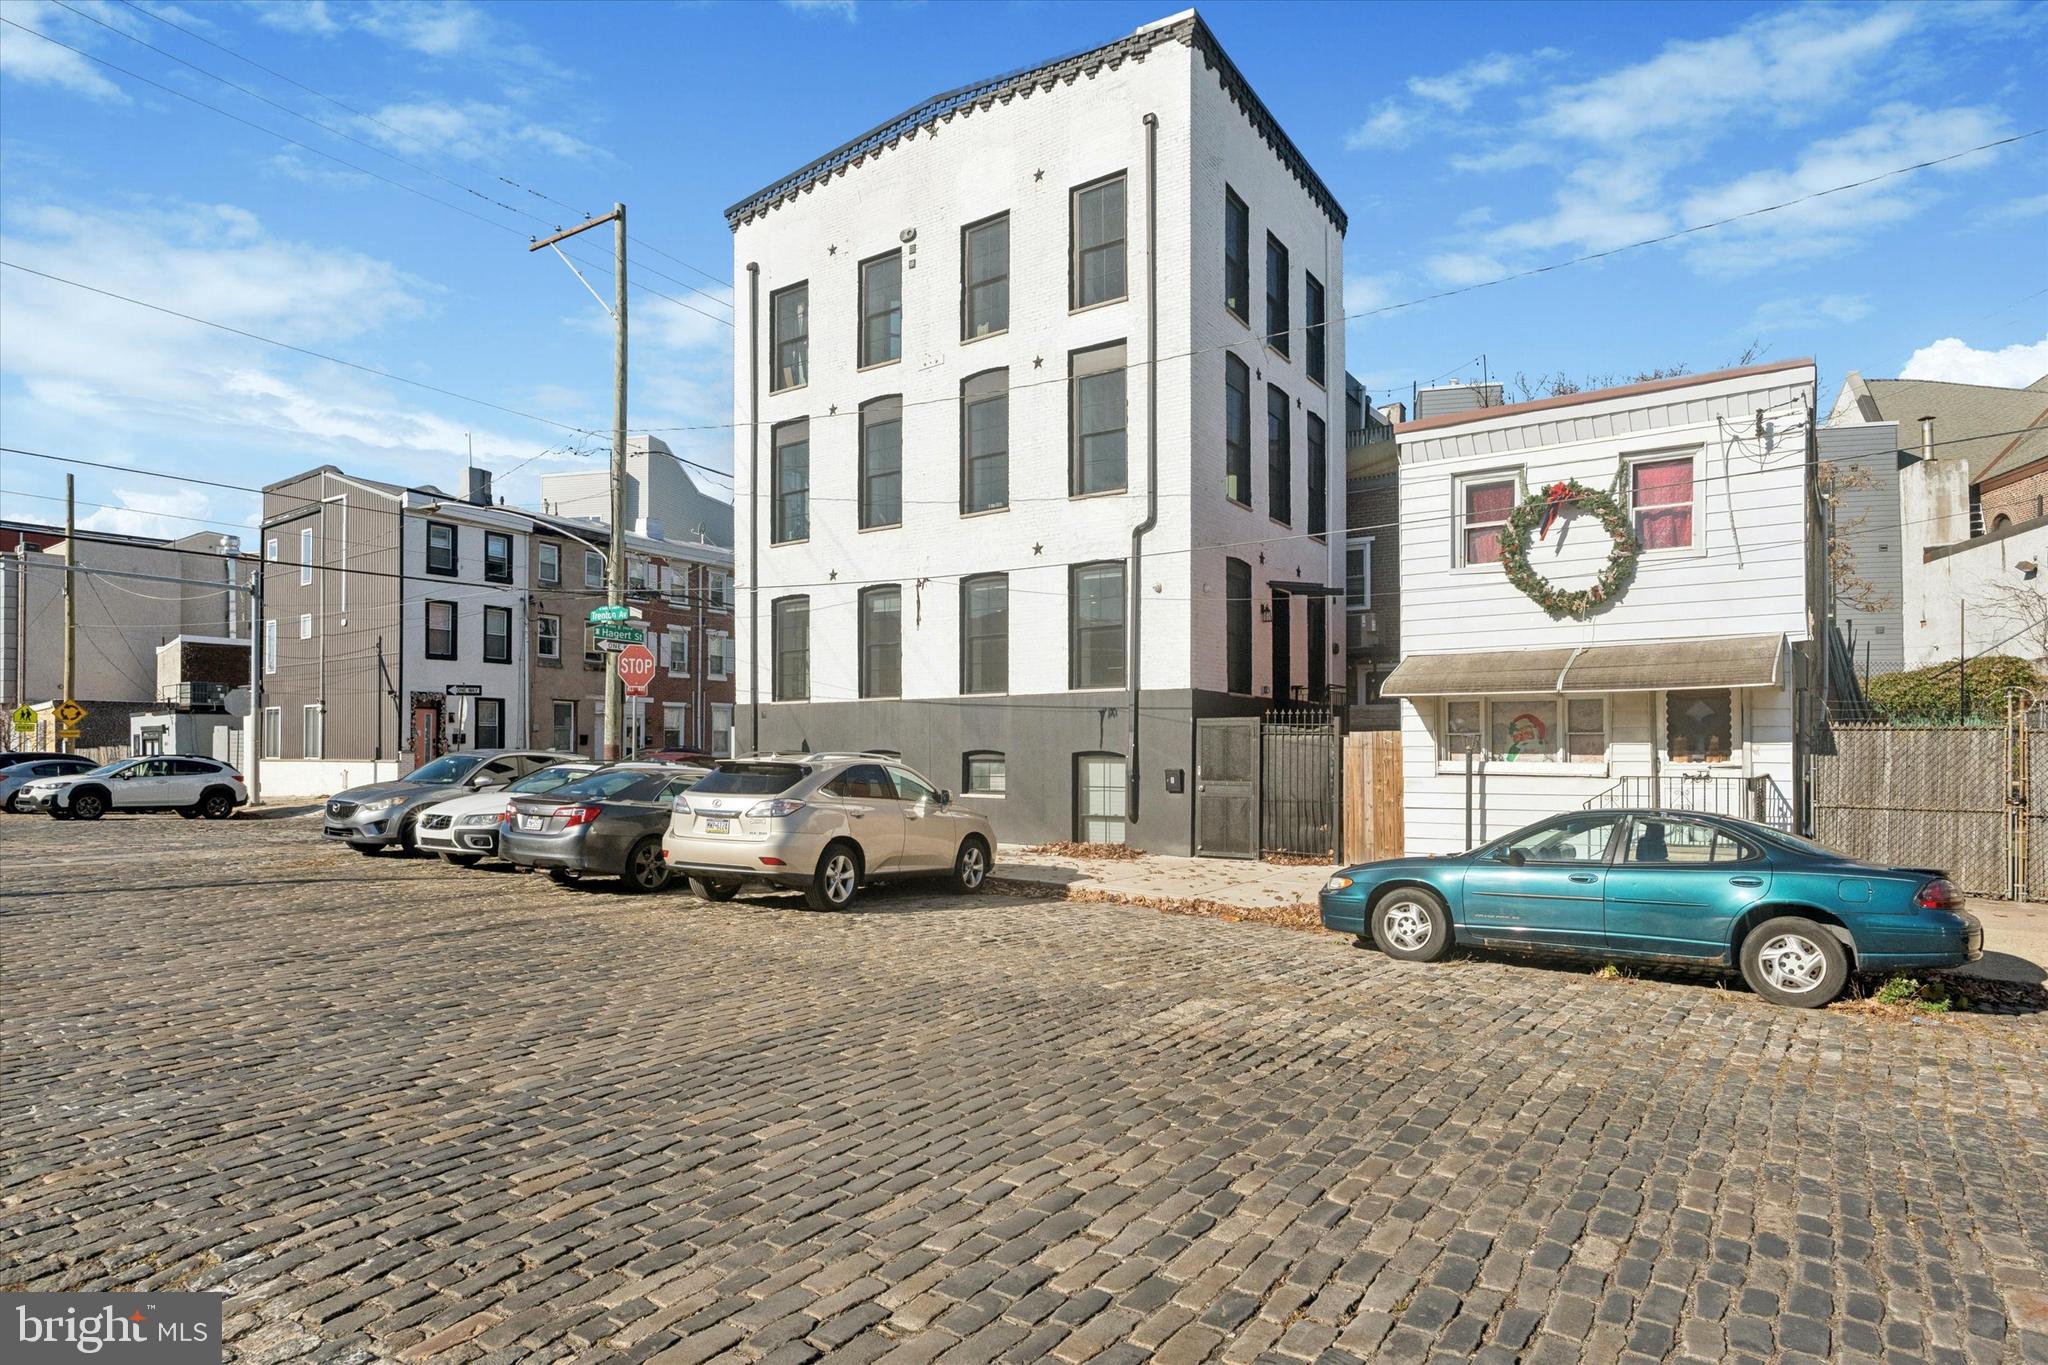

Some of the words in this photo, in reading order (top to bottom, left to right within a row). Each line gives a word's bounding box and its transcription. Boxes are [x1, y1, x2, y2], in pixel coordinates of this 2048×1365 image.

[591, 611, 617, 620] Trenton
[602, 628, 632, 639] Hagert
[634, 632, 643, 641] St
[621, 658, 652, 674] STOP
